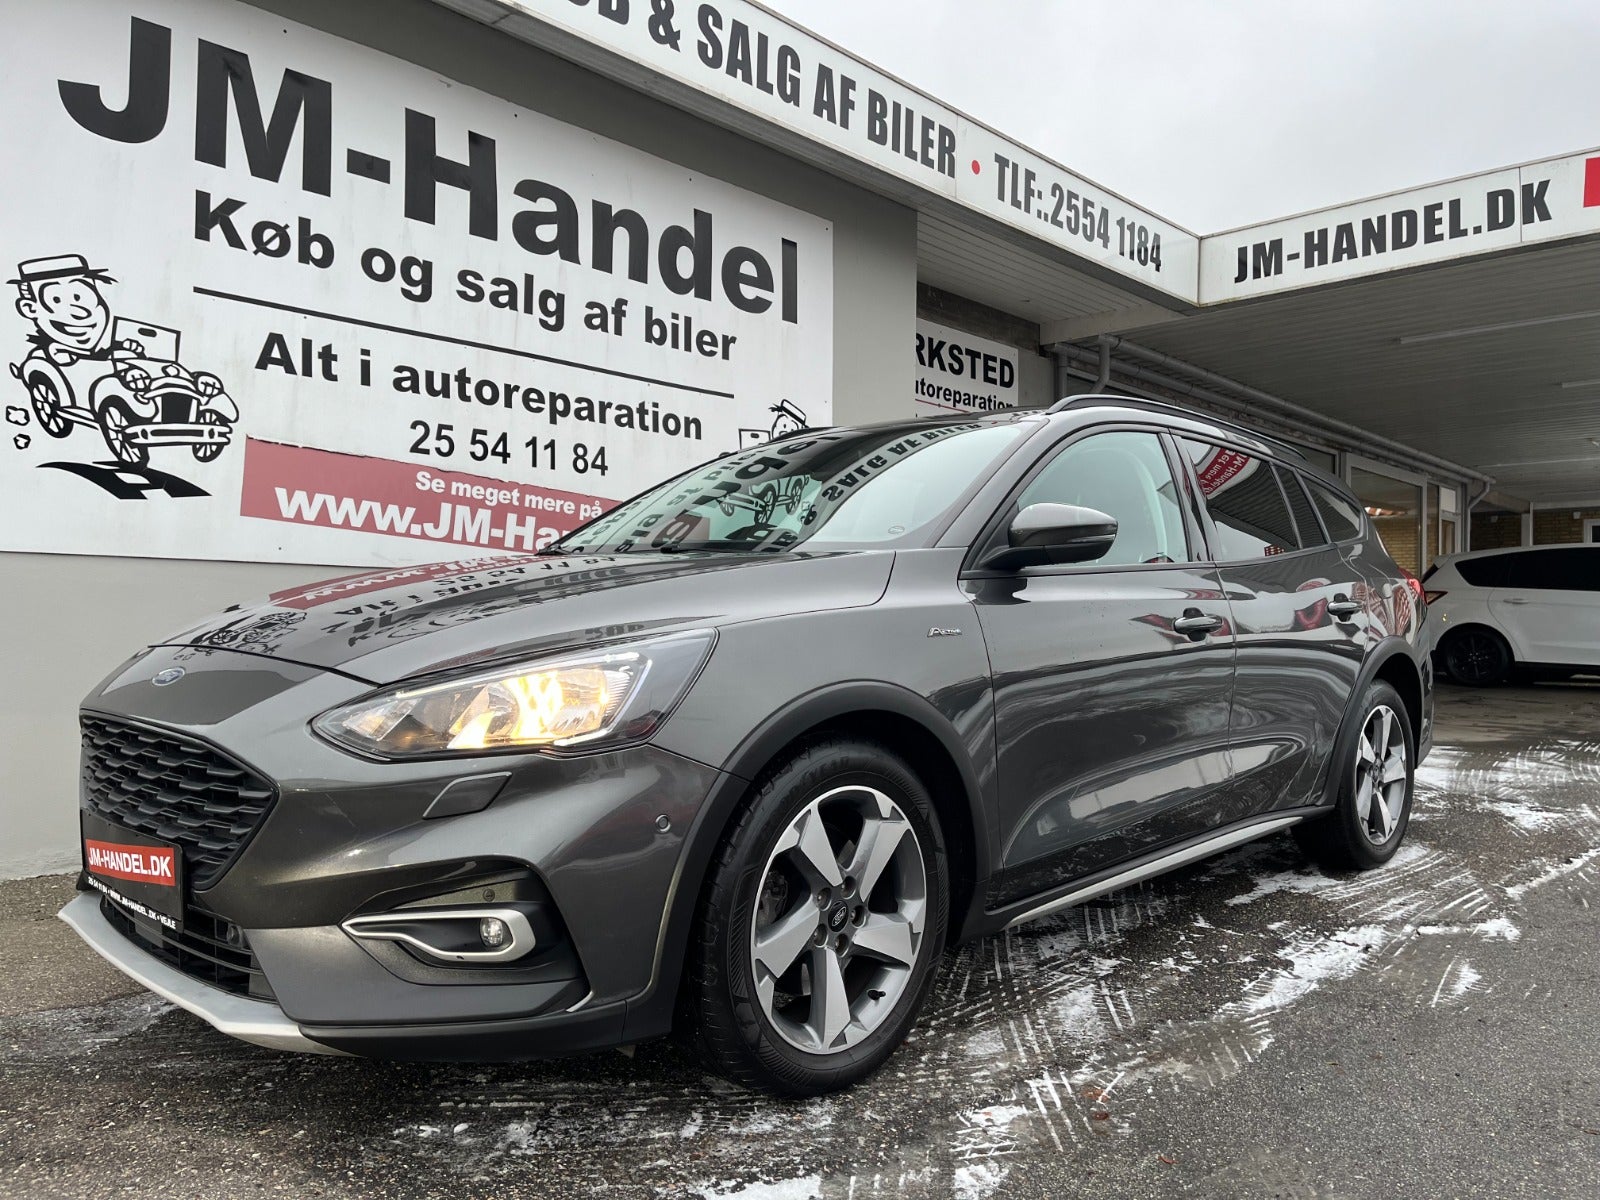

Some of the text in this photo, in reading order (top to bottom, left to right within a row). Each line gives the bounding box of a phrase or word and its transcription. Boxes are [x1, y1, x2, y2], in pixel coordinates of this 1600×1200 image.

[58, 16, 798, 325] JM-Handel
[697, 4, 801, 107] SALG
[813, 62, 856, 131] AF
[867, 87, 956, 179] BILER
[1116, 215, 1162, 273] 1184
[194, 189, 737, 361] Køb og salg af biler
[1234, 179, 1552, 283] JM-HANDEL.DK
[255, 332, 702, 440] Alt i autoreparation
[409, 420, 608, 476] 25 54 11 84
[415, 471, 603, 521] Se meget mere på
[274, 487, 572, 553] www.JM-Ha
[88, 847, 172, 878] JM-HANDEL.DK
